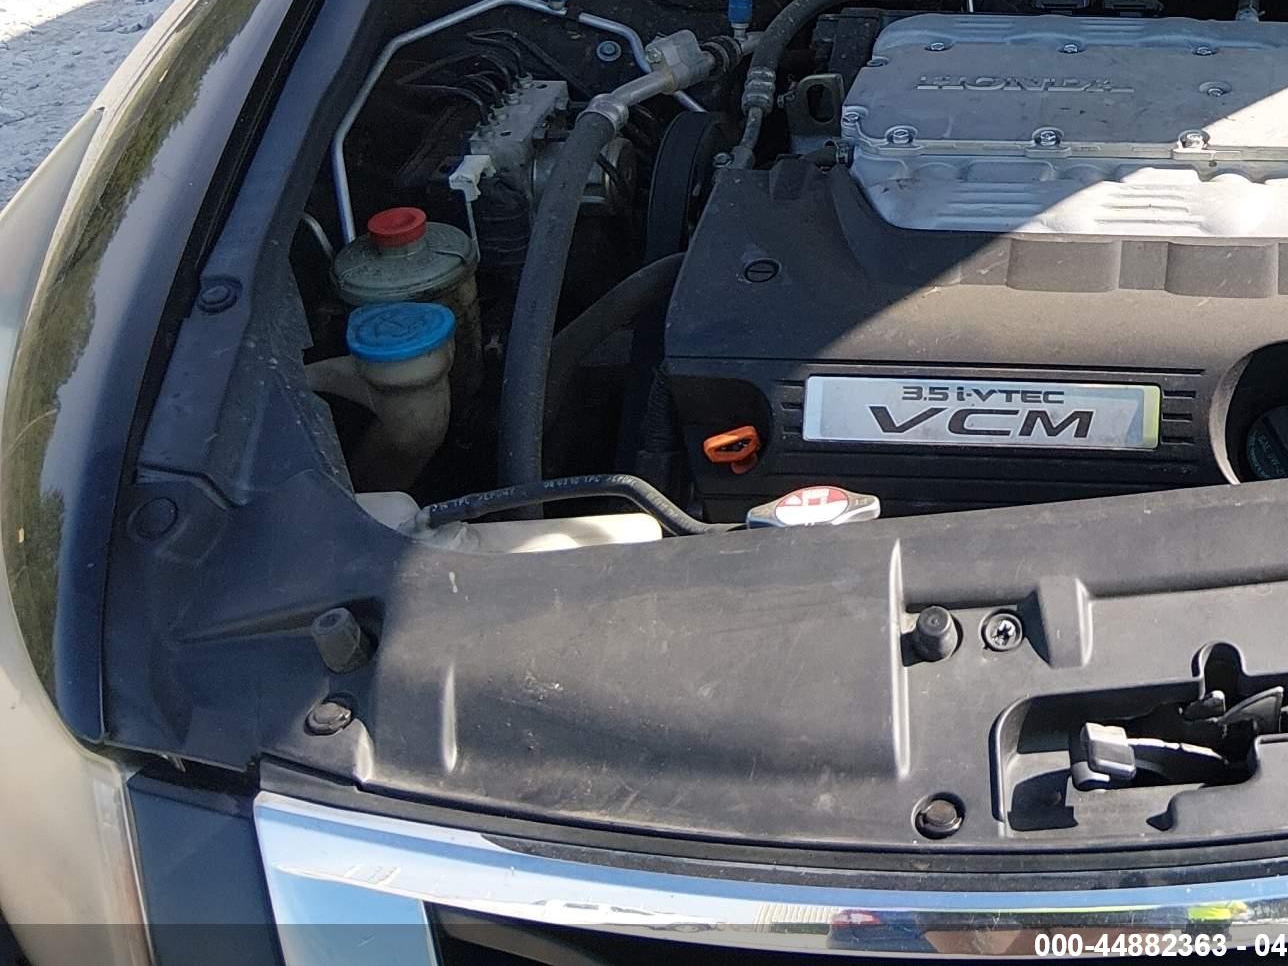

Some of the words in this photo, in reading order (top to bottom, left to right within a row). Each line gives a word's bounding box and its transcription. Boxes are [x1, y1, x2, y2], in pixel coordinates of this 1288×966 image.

[917, 76, 1135, 93] HONDA
[902, 385, 949, 402] 3.5
[956, 386, 1066, 404] i-VTEC
[868, 405, 1095, 439] VCM
